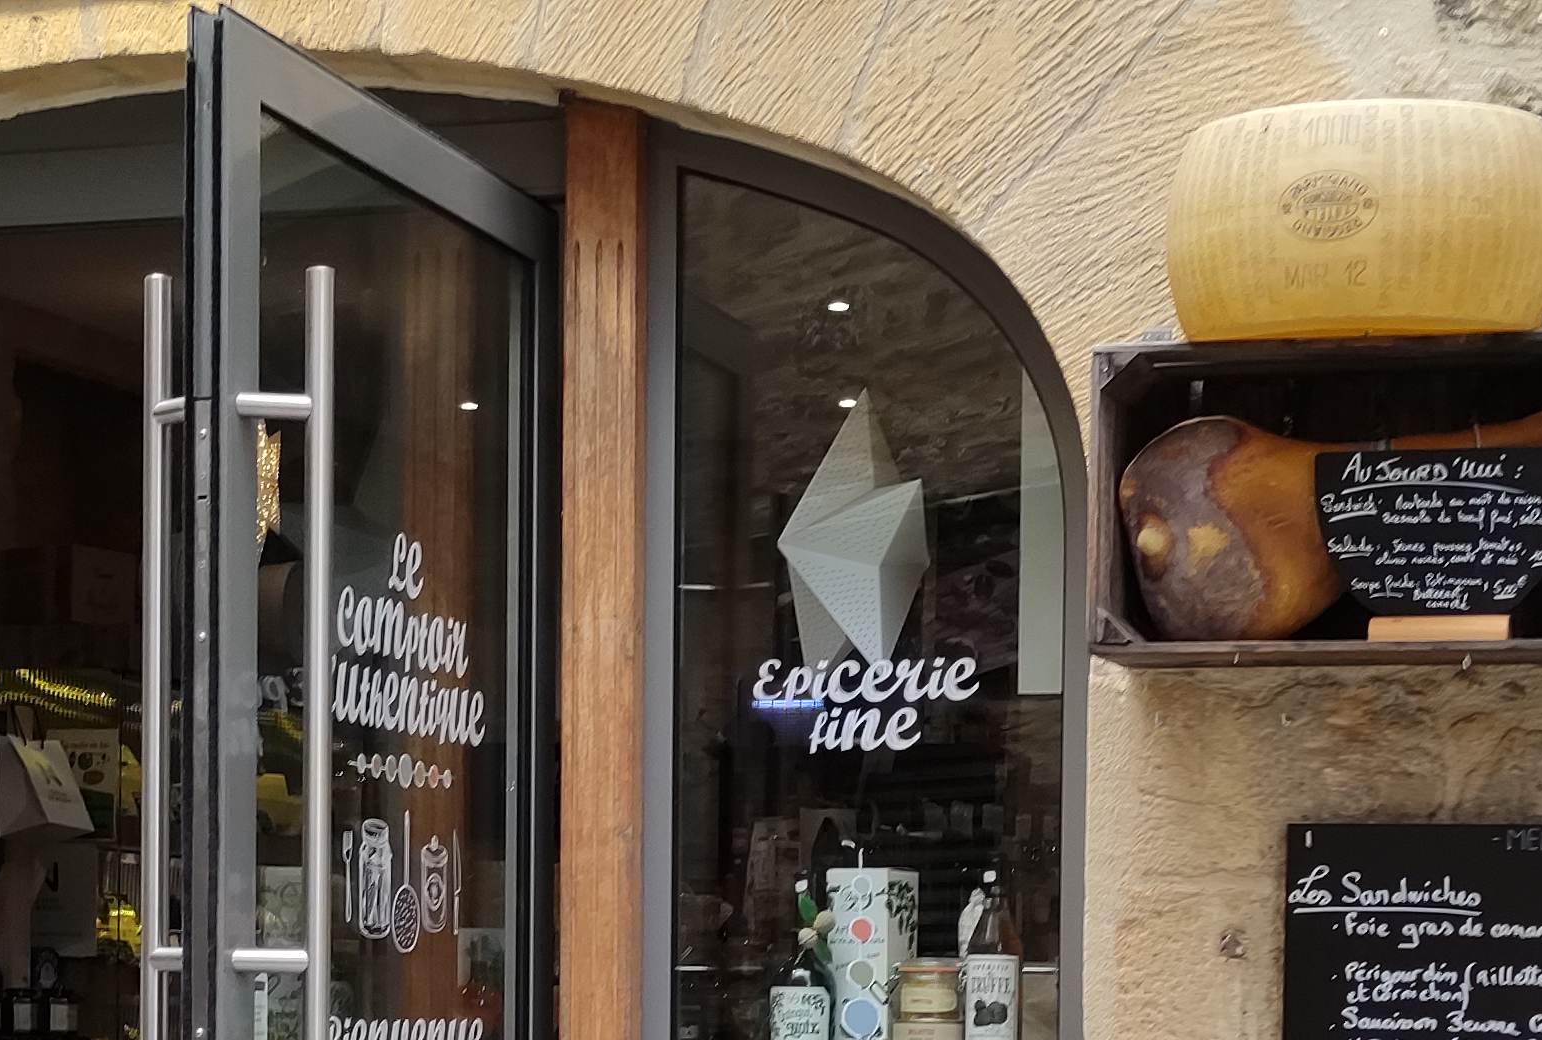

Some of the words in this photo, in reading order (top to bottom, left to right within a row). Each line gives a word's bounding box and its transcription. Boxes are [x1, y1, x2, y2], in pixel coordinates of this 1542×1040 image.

[387, 532, 425, 599] Le
[336, 586, 470, 679] Comptoir
[751, 656, 981, 703] Epicerie
[808, 706, 922, 754] fine
[1288, 864, 1333, 906] Les
[1340, 871, 1482, 907] Sandwiches
[1397, 919, 1455, 950] gras
[1344, 960, 1459, 987] Périgourdin
